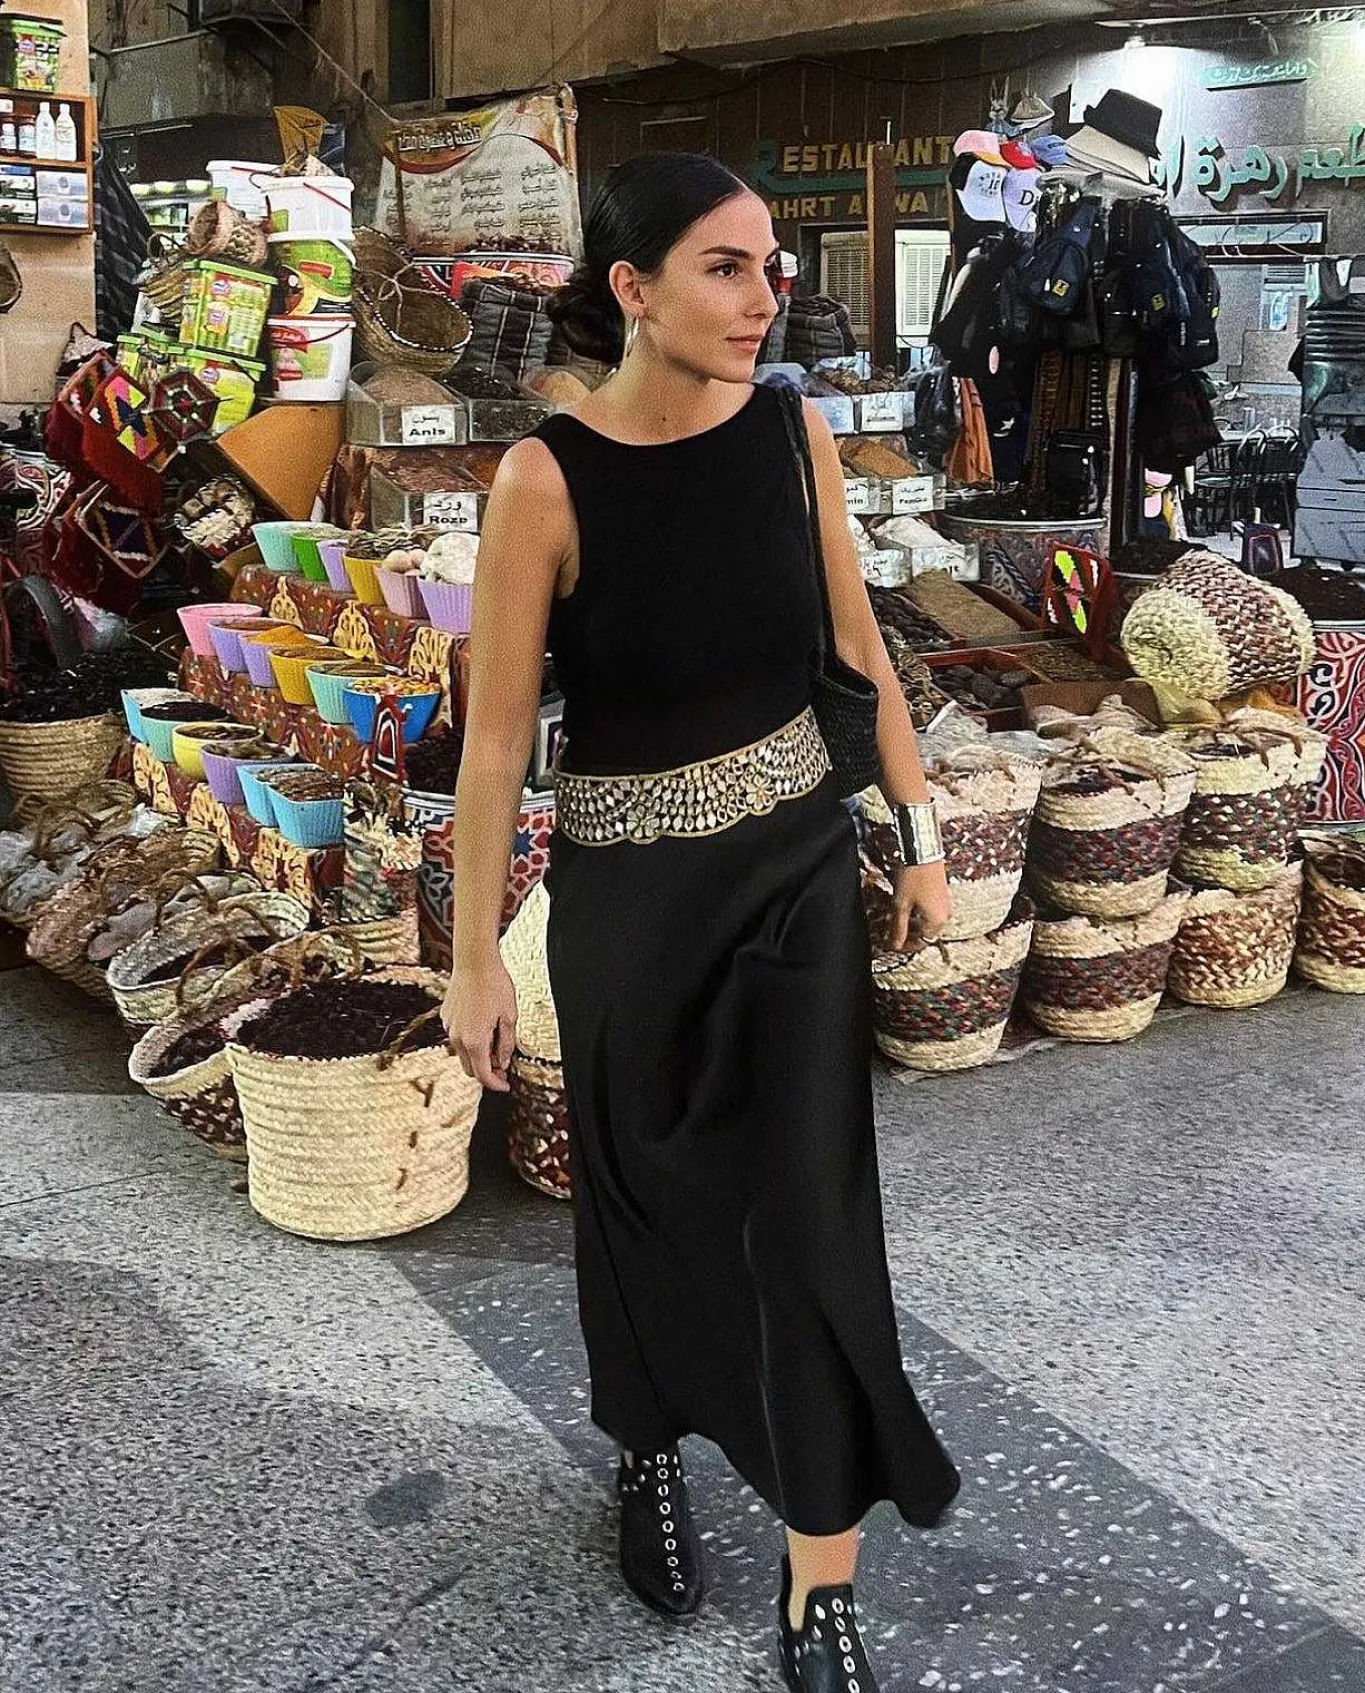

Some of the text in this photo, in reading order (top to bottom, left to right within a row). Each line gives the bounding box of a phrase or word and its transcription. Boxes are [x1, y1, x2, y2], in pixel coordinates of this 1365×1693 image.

[754, 136, 953, 190] RESTAUANT
[1297, 122, 1365, 199] طعم
[769, 196, 836, 220] AHRT
[409, 427, 446, 437] Anis
